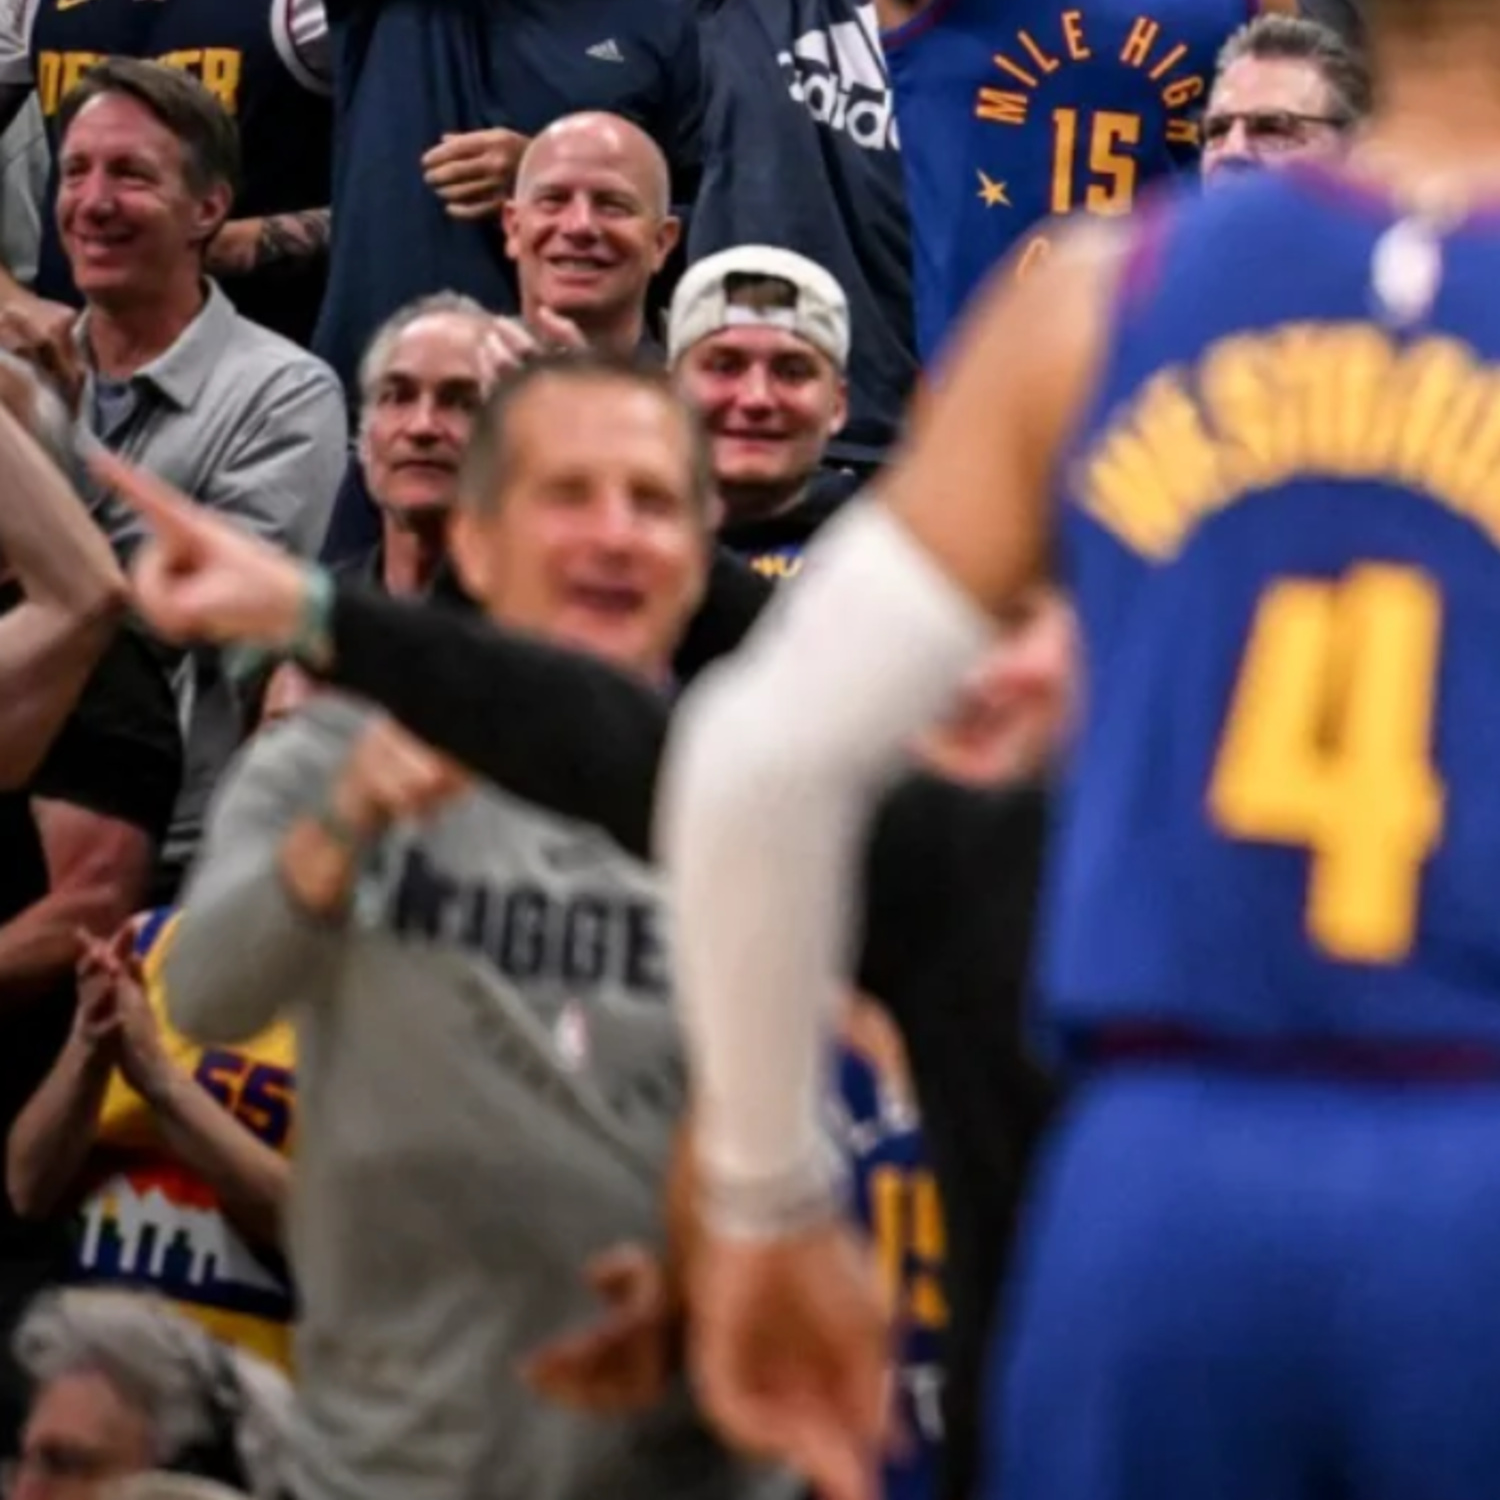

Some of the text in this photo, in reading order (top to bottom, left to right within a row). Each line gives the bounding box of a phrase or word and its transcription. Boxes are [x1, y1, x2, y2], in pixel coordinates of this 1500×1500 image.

[975, 9, 1092, 126] MILE
[1051, 106, 1142, 217] 15
[1206, 558, 1447, 965] 4
